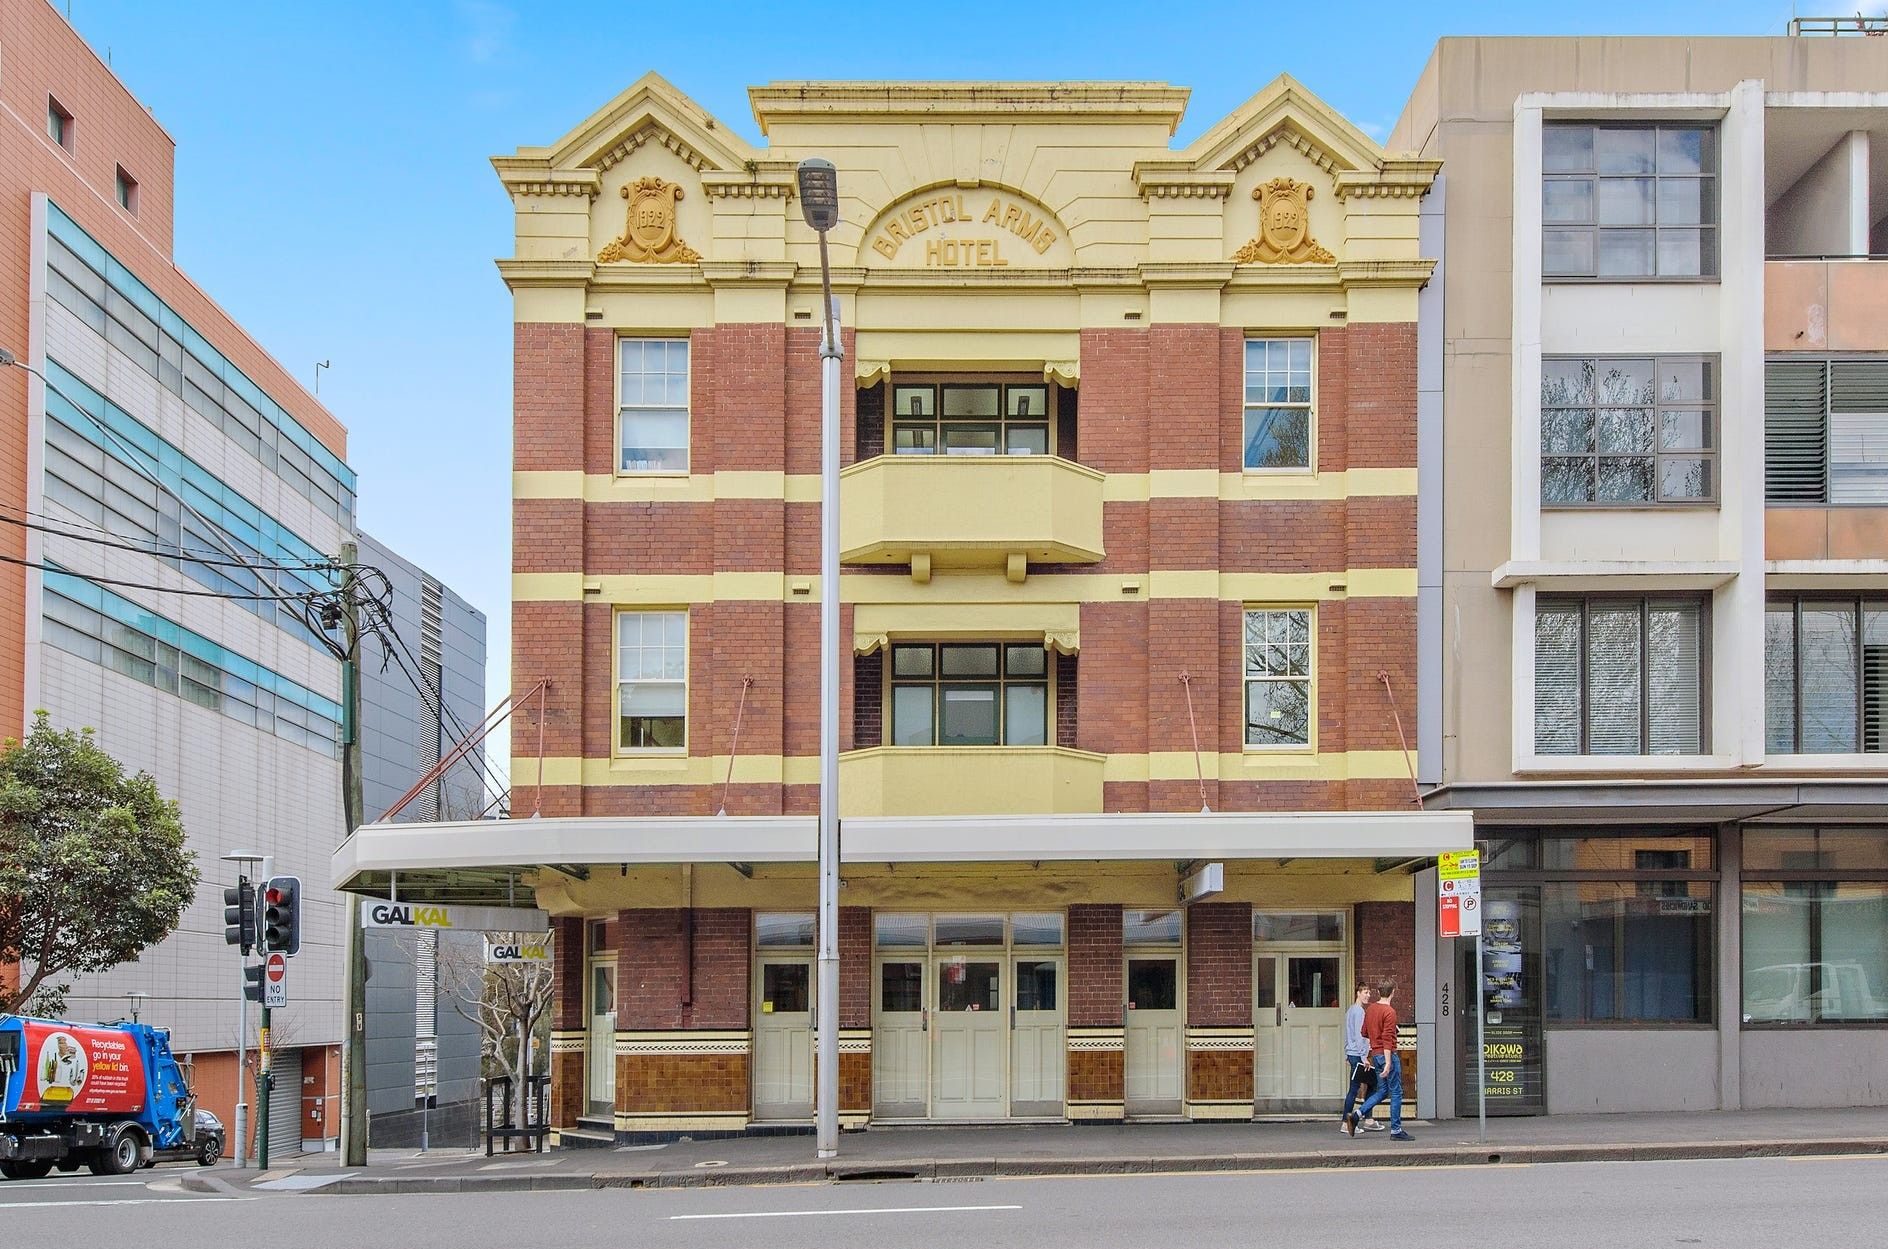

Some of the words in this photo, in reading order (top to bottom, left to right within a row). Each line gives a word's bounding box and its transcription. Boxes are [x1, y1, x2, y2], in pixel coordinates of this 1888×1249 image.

[636, 209, 665, 230] 1922
[1270, 211, 1298, 231] 1922
[872, 194, 972, 260] BRISTOL
[982, 198, 1057, 255] ARMS
[926, 239, 1008, 266] HOTEL
[371, 905, 453, 927] GALKAL
[493, 945, 549, 960] GALKAL
[270, 985, 281, 993] NO
[266, 996, 285, 1004] ENTRY
[91, 1039, 126, 1050] Recyclables
[92, 1051, 102, 1061] go
[102, 1051, 108, 1059] in
[108, 1053, 121, 1062] your
[92, 1061, 111, 1072] yellow
[111, 1062, 119, 1071] lid
[119, 1063, 129, 1072] bin.
[1490, 1071, 1514, 1082] 428
[1512, 1087, 1523, 1095] ST
